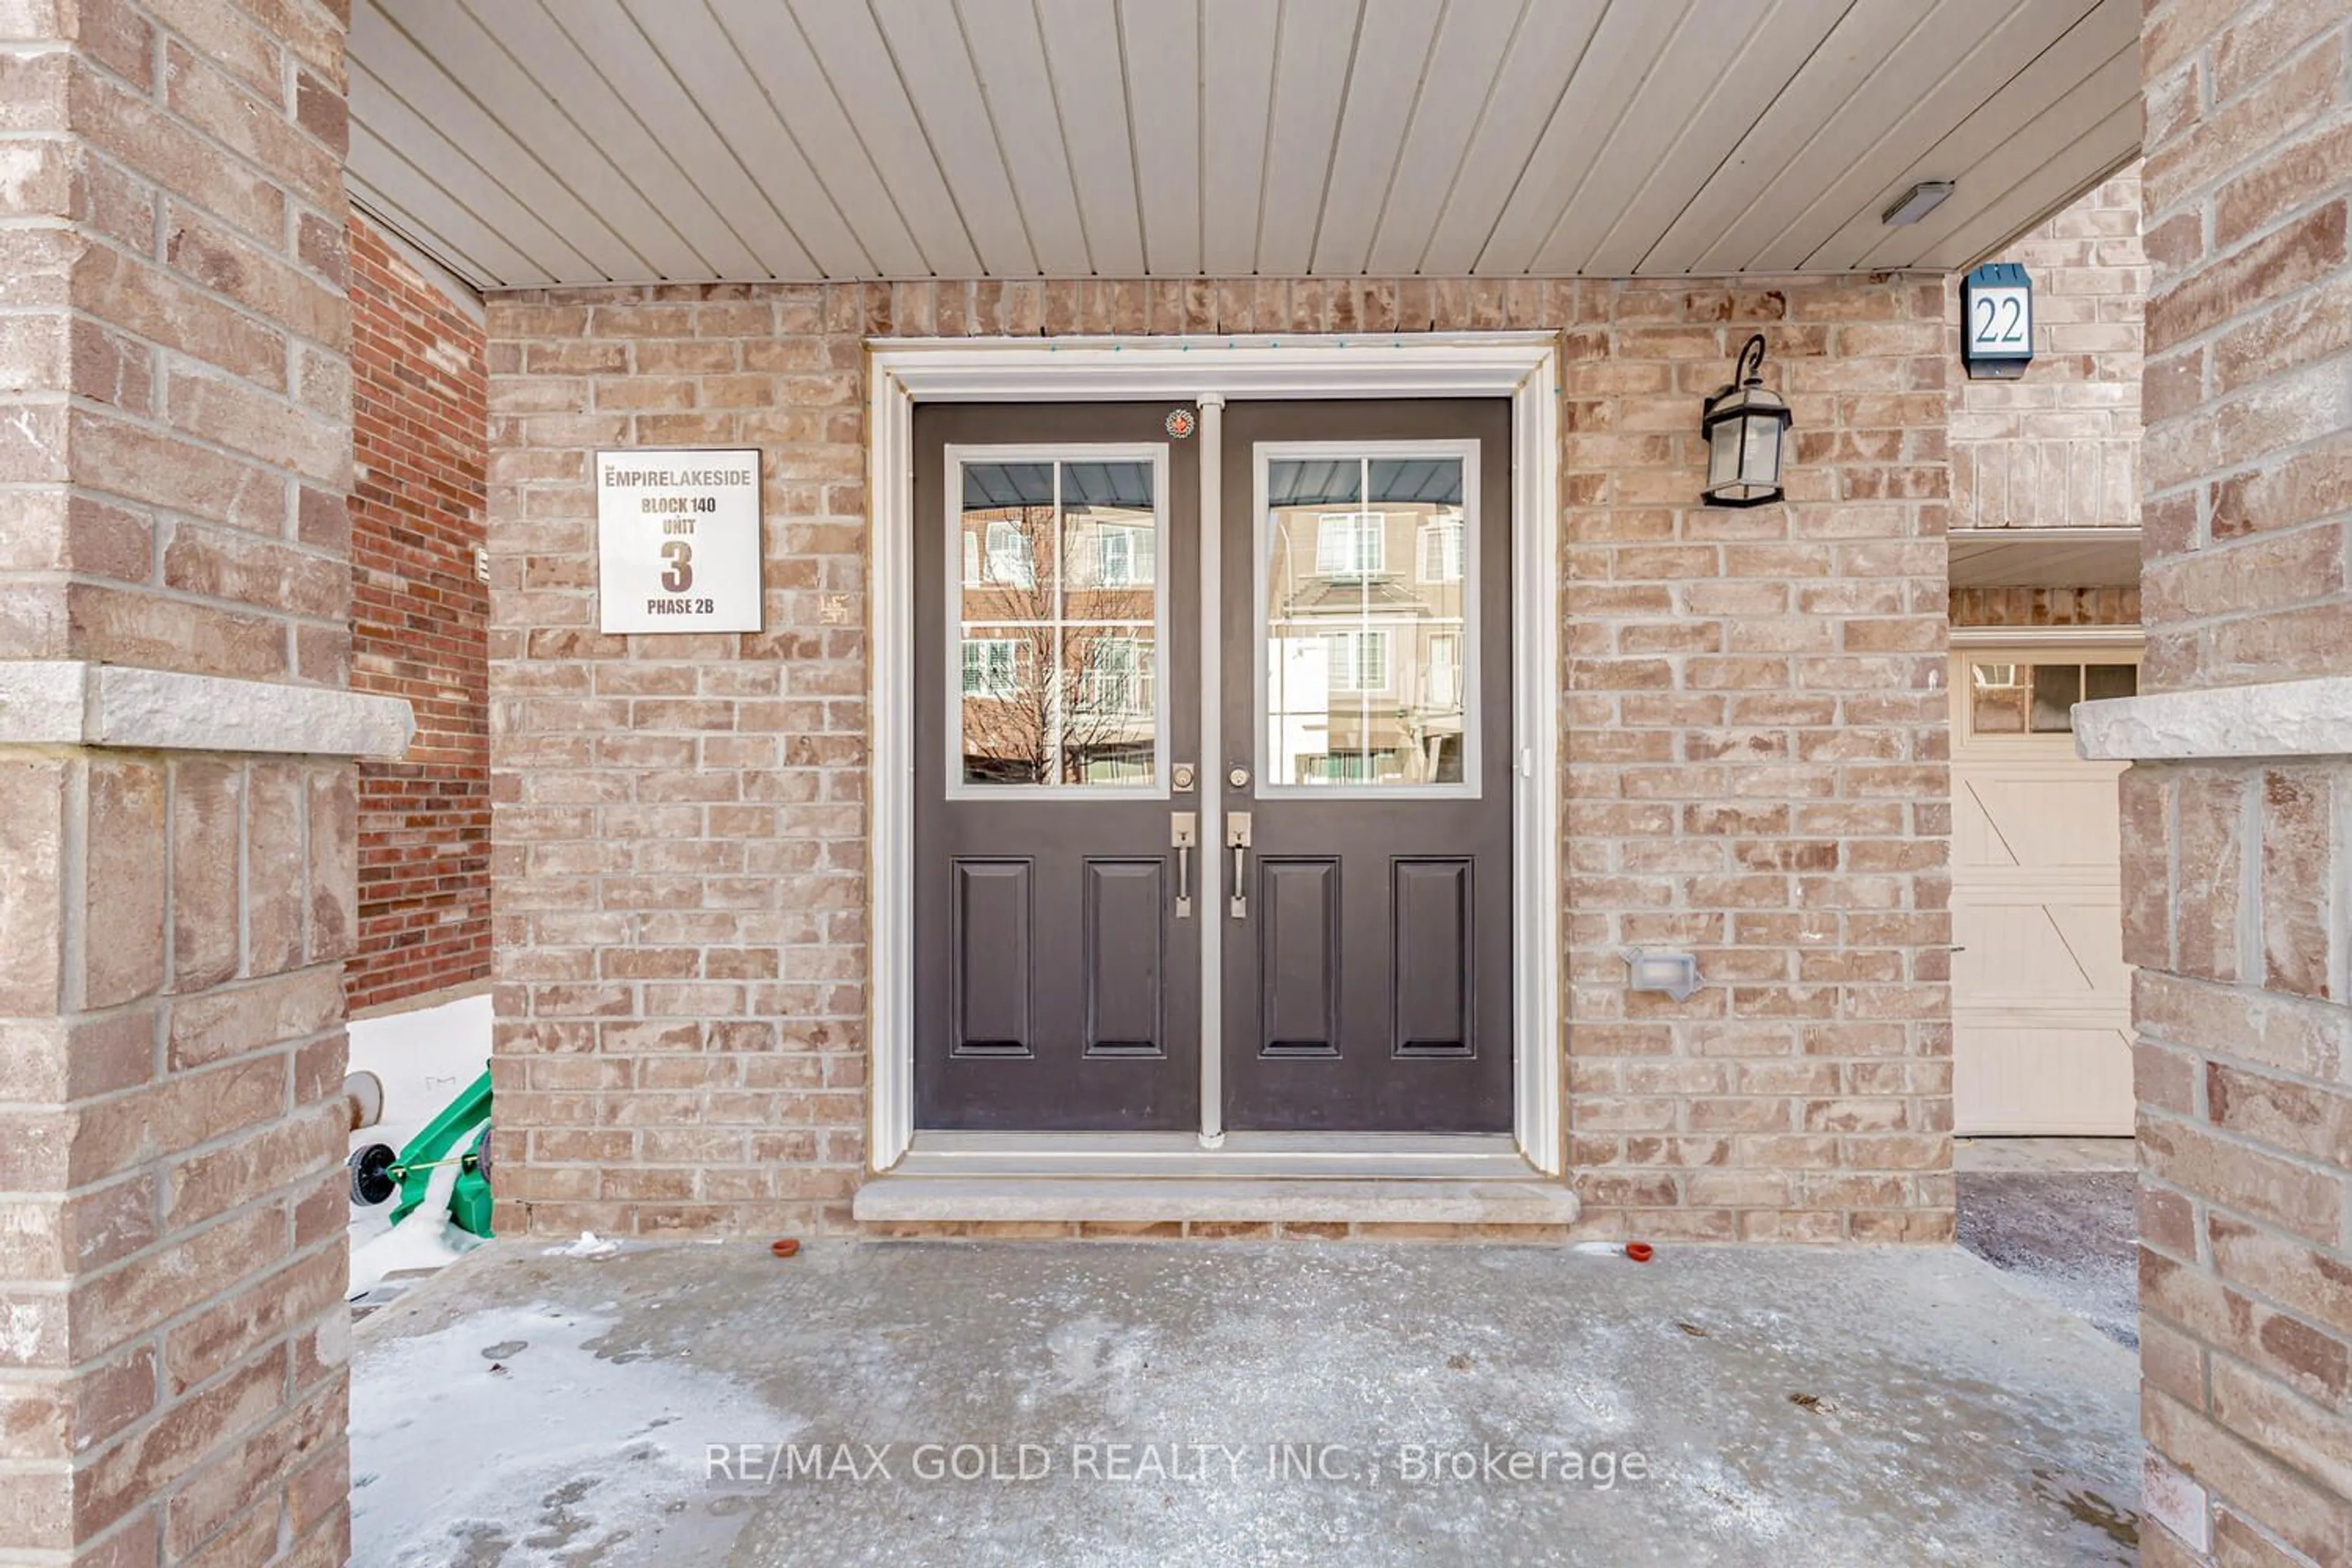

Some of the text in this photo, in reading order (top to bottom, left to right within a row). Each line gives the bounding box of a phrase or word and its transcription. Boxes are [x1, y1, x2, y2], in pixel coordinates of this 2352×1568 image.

[1976, 296, 2023, 342] 22
[641, 496, 715, 513] BLOCK 140
[663, 519, 696, 535] UNIT
[660, 541, 693, 593] 3
[647, 598, 714, 614] PHASE 2B
